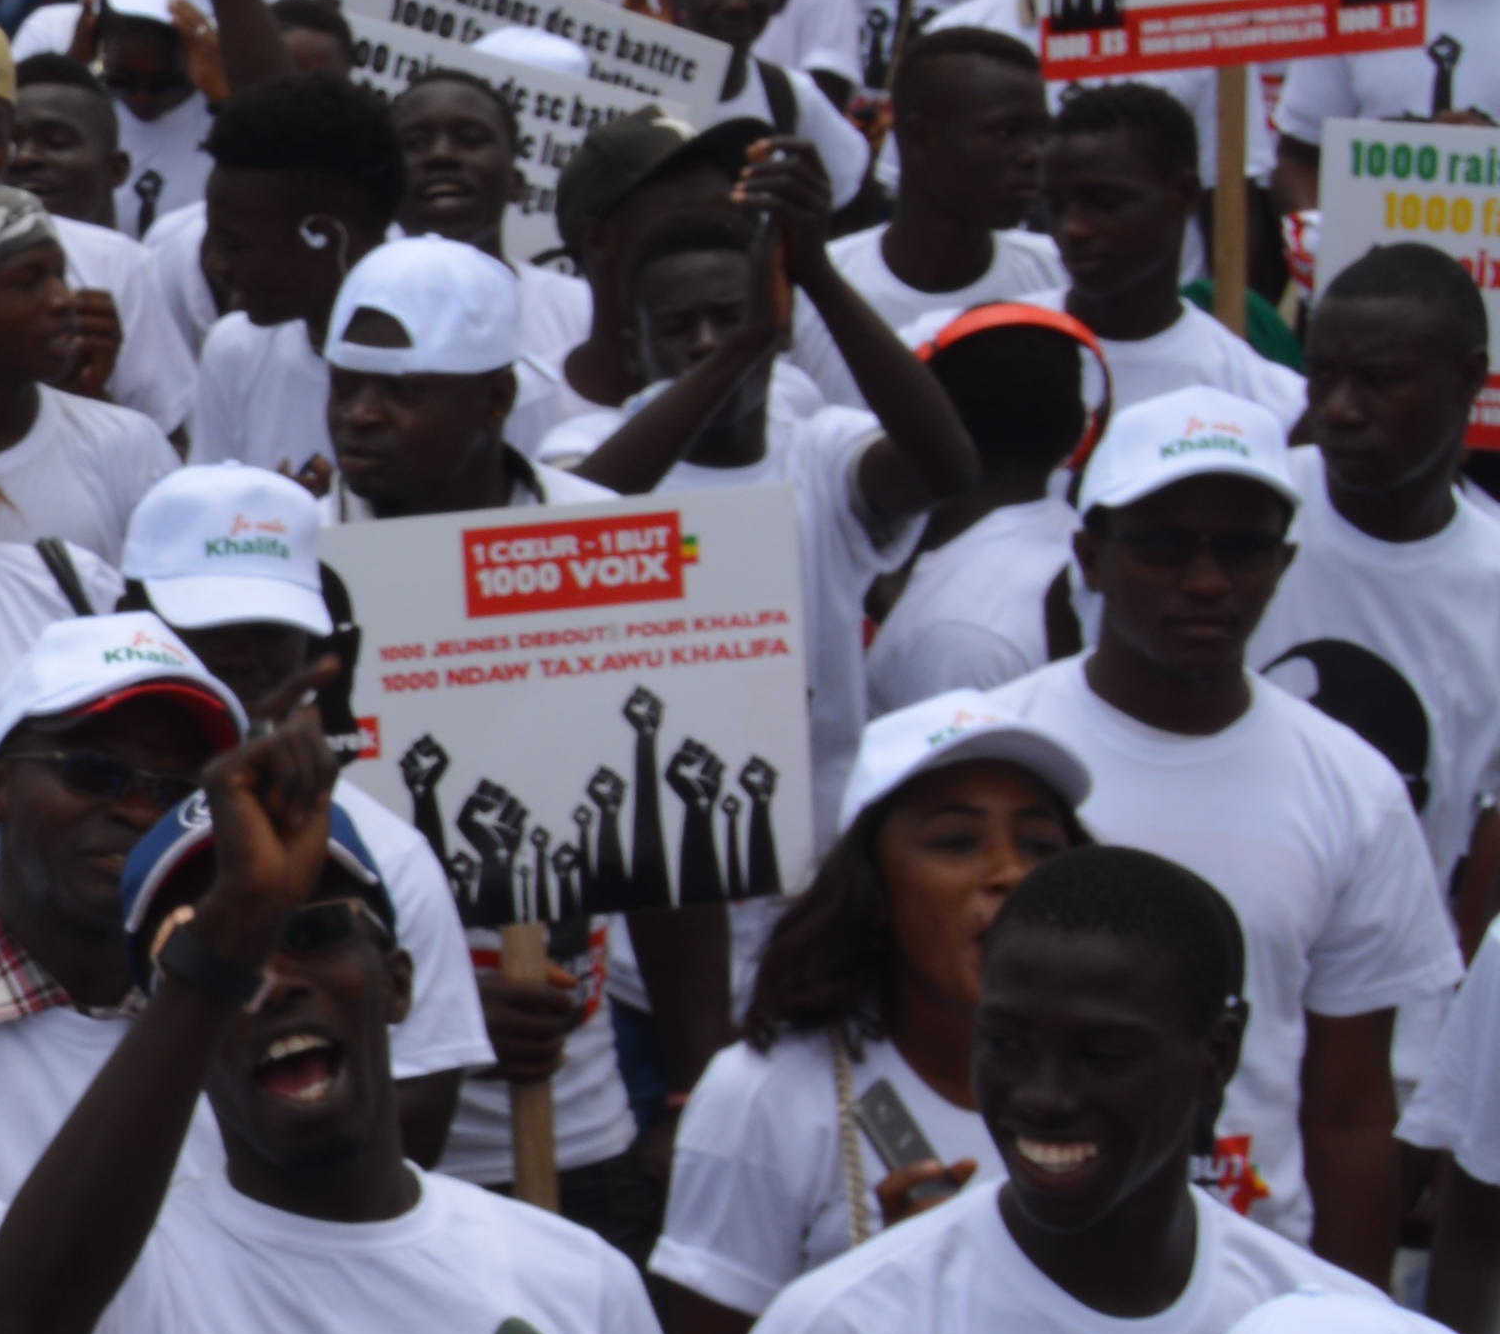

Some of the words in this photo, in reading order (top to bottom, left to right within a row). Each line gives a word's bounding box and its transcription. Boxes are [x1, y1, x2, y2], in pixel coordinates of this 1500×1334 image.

[545, 5, 580, 39] de
[582, 23, 612, 53] se
[617, 27, 698, 83] battre
[1351, 139, 1440, 181] 1000
[203, 535, 292, 563] Khalifa
[475, 563, 563, 597] 1000
[569, 551, 670, 589] VOIX
[378, 644, 428, 662] 1000
[432, 636, 512, 659] JEUNES
[624, 618, 687, 640] POUR
[693, 608, 790, 635] KHALIFA
[381, 668, 441, 694] 1000
[446, 662, 531, 689] NDAW
[540, 648, 665, 681] TAXAWU
[671, 637, 791, 666] KHALIFA
